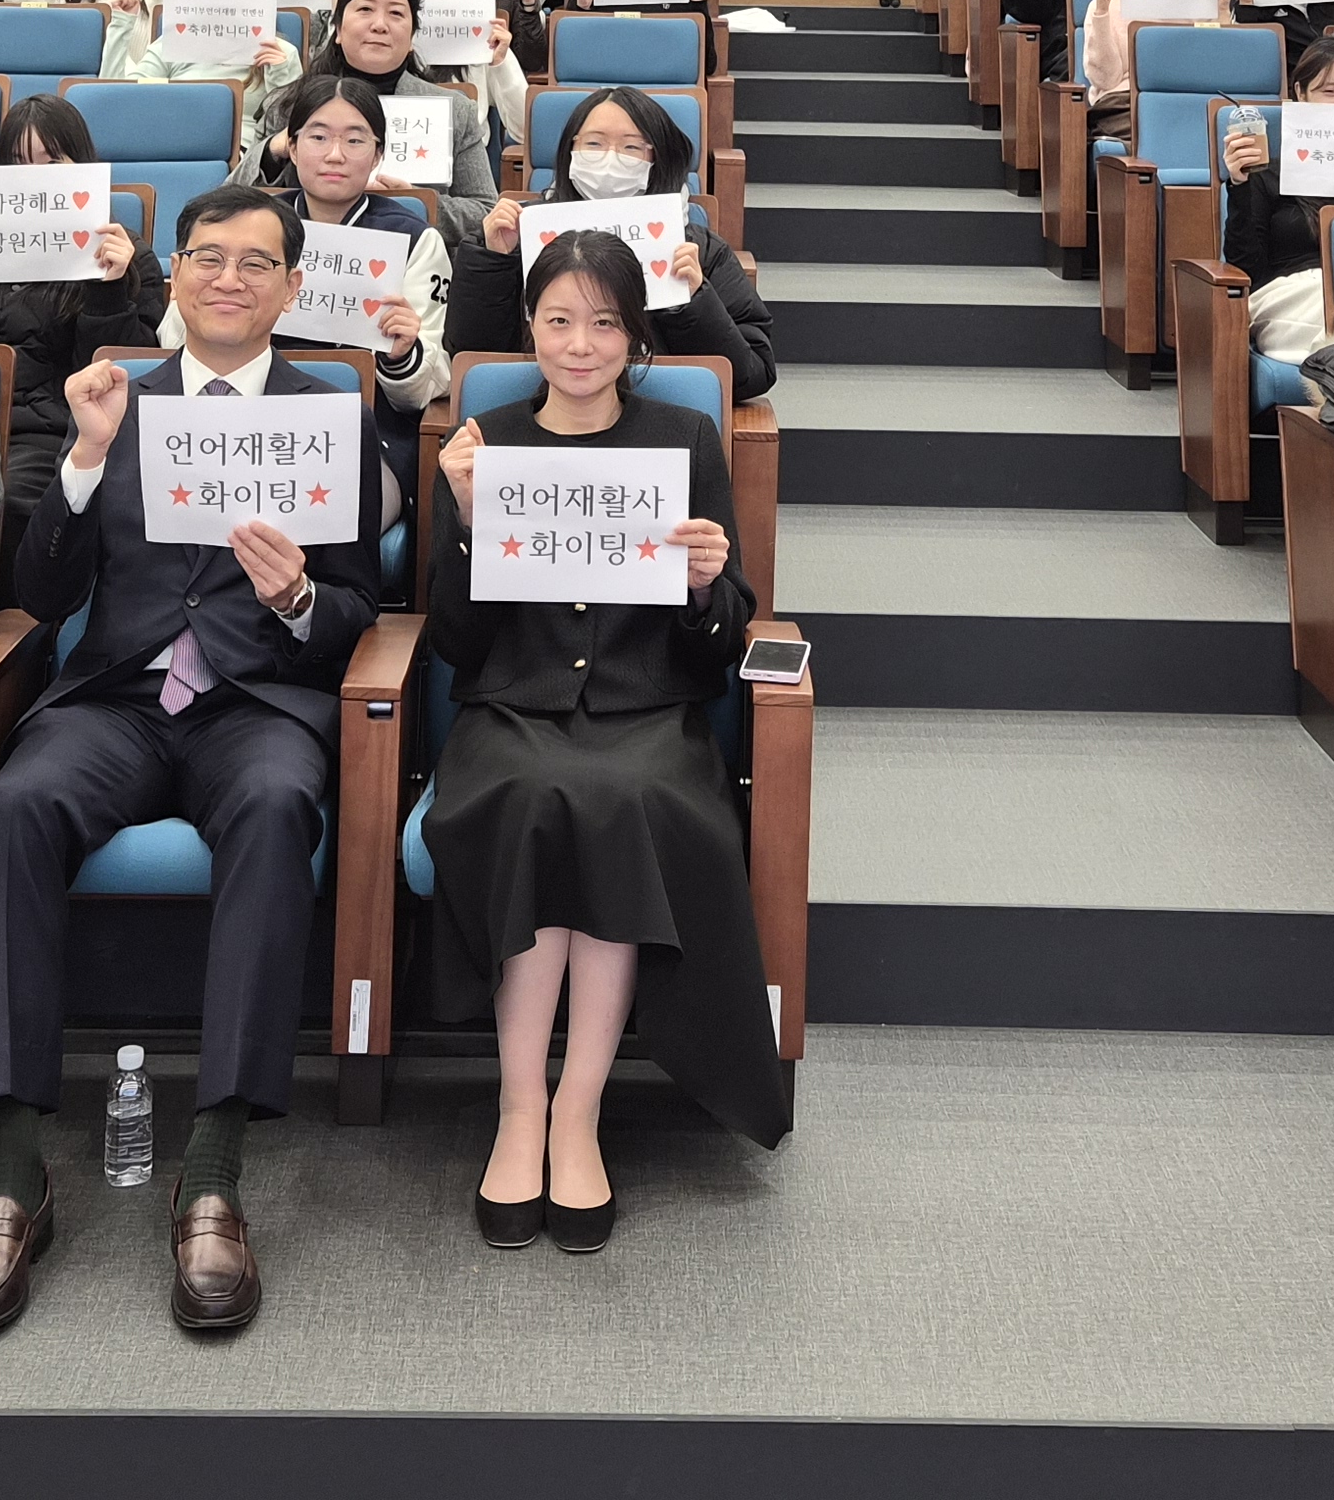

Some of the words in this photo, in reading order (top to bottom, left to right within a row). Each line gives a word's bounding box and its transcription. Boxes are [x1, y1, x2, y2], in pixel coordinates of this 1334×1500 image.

[187, 24, 251, 39] 축하합니다
[418, 25, 470, 38] 하합니다
[301, 249, 364, 278] 랑해요
[296, 288, 359, 317] 원지부
[165, 430, 337, 468] 언어재활사
[198, 479, 297, 515] 화이팅
[498, 483, 665, 520] 언어재활사
[528, 530, 627, 566] 화이팅
